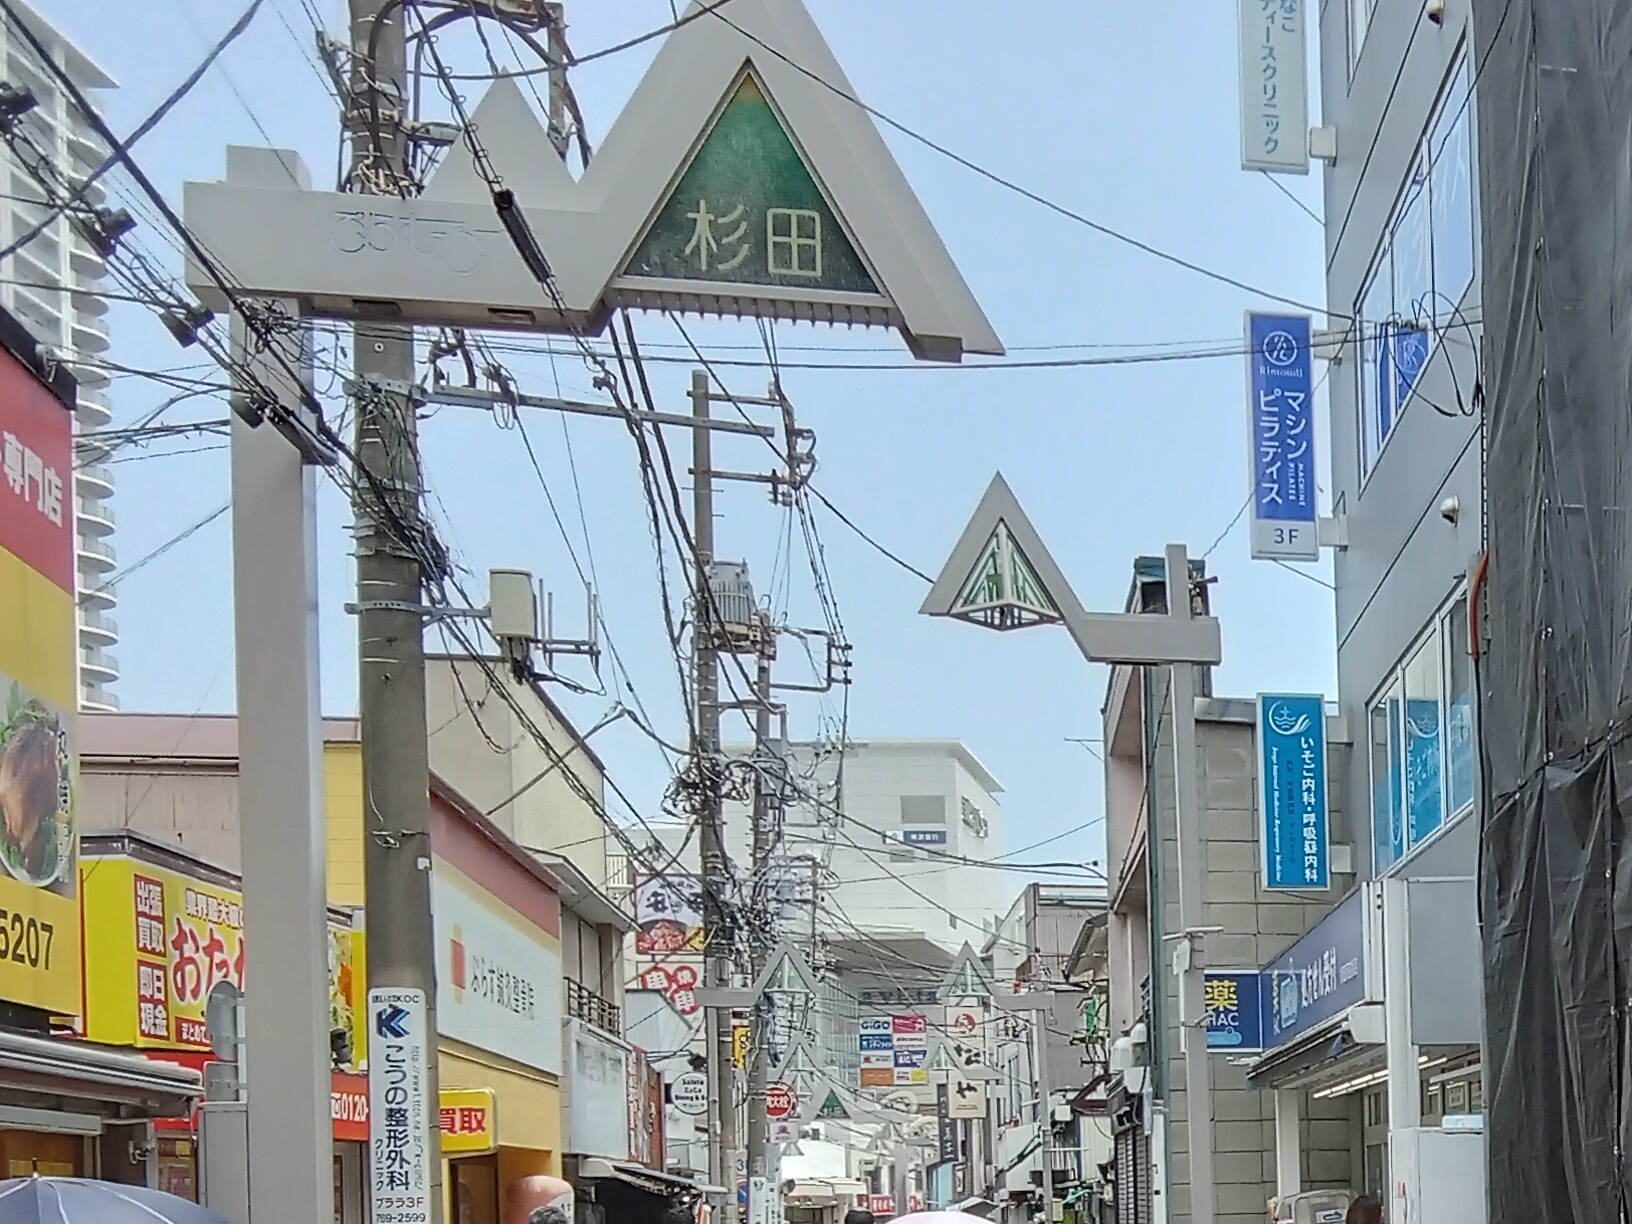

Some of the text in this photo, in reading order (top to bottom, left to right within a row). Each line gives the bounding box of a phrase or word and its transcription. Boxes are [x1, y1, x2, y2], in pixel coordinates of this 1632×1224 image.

[685, 199, 822, 277] 杉田
[1284, 391, 1307, 459] マシン
[0, 430, 63, 528] 専門店
[1273, 528, 1299, 545] 3F
[137, 881, 163, 917] 出張
[138, 918, 165, 954] 買取
[139, 966, 166, 1001] 即日
[1204, 979, 1239, 1012] 薬
[140, 1003, 168, 1037] 現金
[384, 1044, 412, 1192] こうの整形外科
[440, 1106, 487, 1135] 買取
[374, 1138, 385, 1192] クリニック
